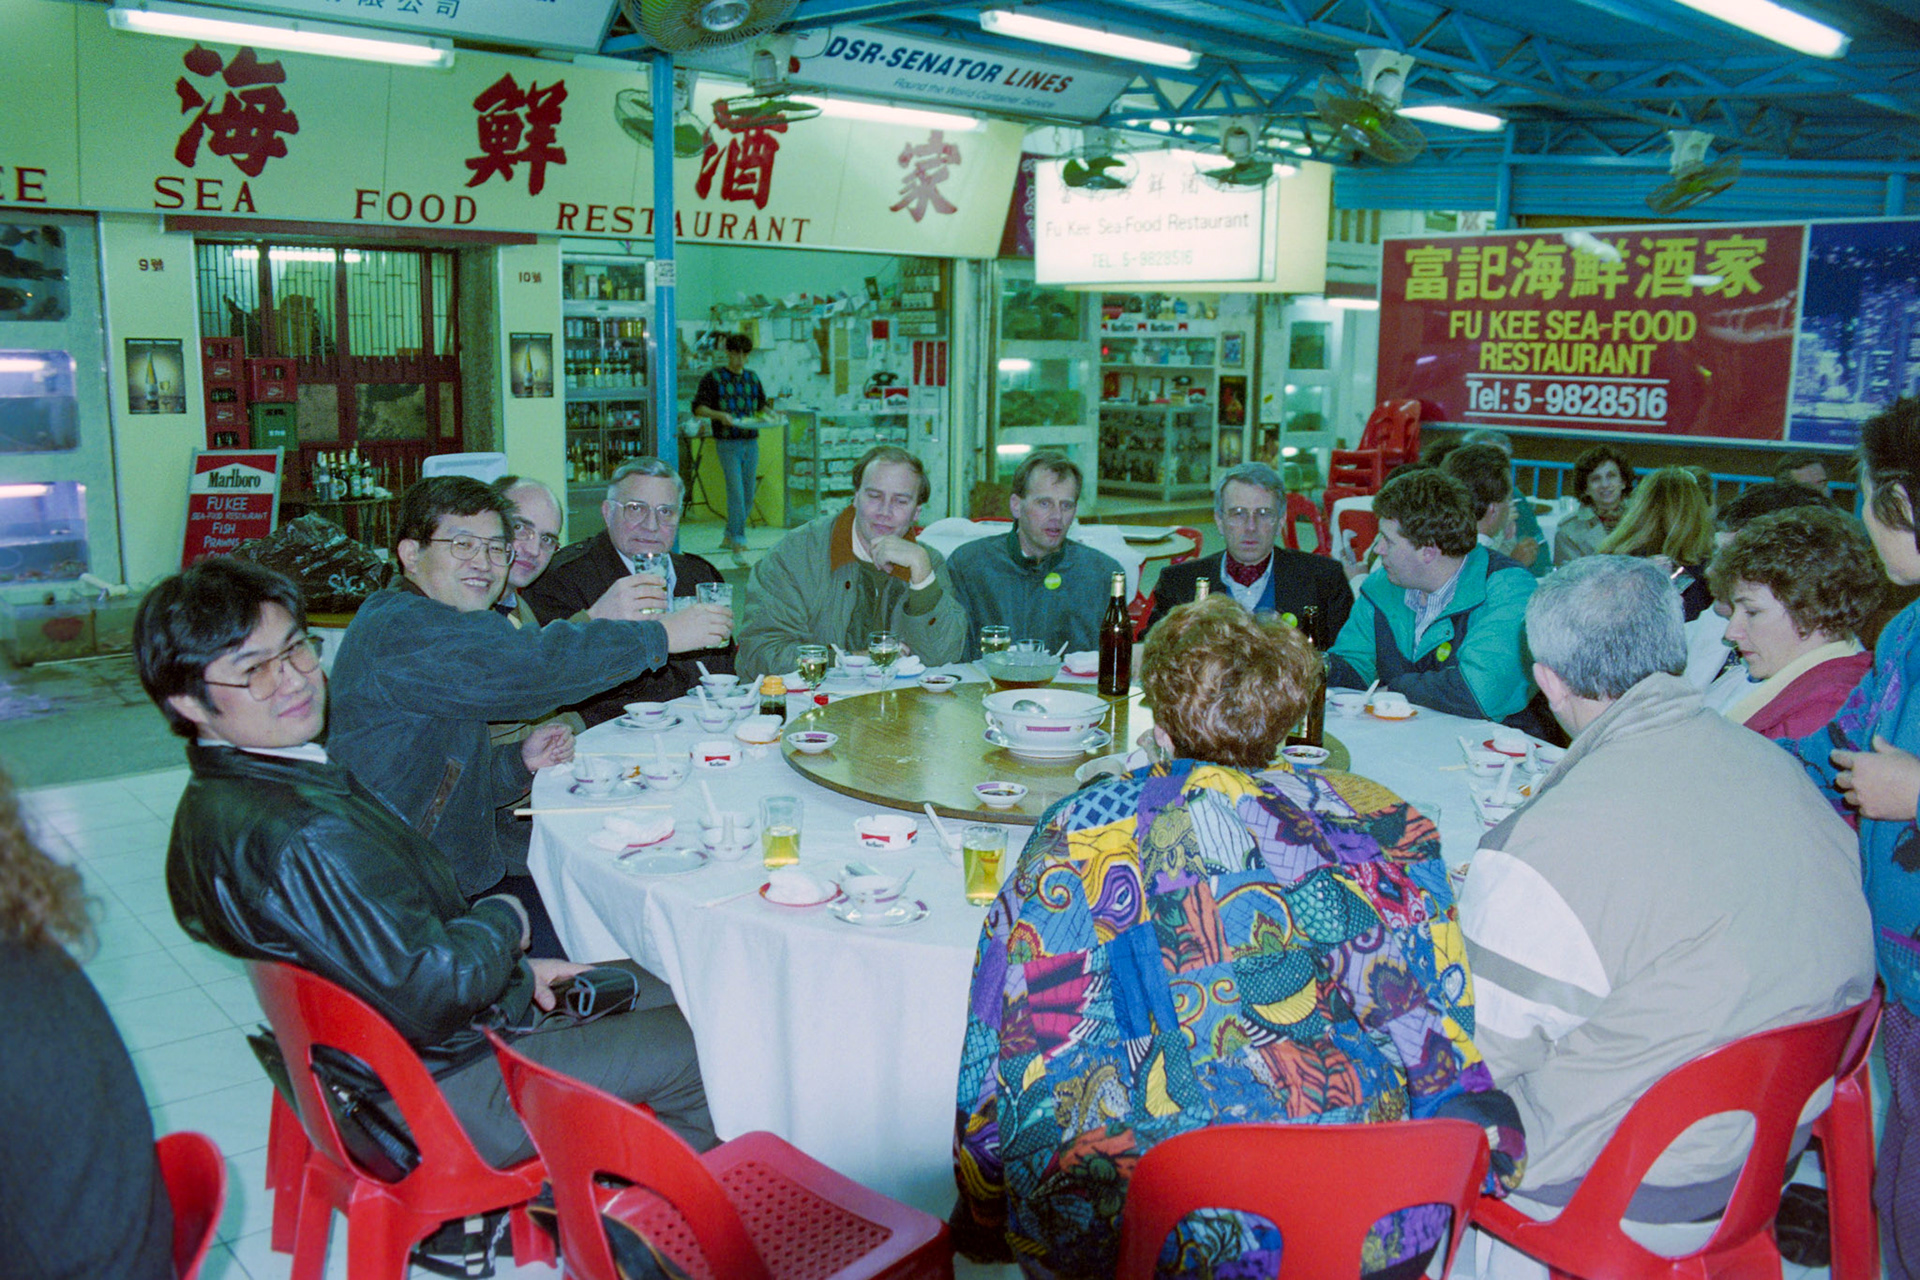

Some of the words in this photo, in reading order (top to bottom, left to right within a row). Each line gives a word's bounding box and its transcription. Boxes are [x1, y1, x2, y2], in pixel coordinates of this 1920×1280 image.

[1003, 67, 1074, 94] LINES
[0, 165, 48, 204] E
[154, 175, 259, 214] SEA
[353, 188, 477, 225] FOOD
[1168, 212, 1250, 231] Restaurant
[1404, 234, 1768, 301] 富記海鮮酒家
[1449, 309, 1482, 339] FU
[1489, 310, 1541, 340] KEE
[1545, 309, 1697, 342] SEA-FOOD
[1479, 341, 1657, 375] RESTAURANT
[1465, 380, 1509, 411] Tel:
[1513, 382, 1668, 419] 5-9828516
[208, 468, 261, 488] Marlboro
[206, 496, 224, 510] FU
[225, 497, 249, 510] KEE
[212, 522, 236, 534] FISH
